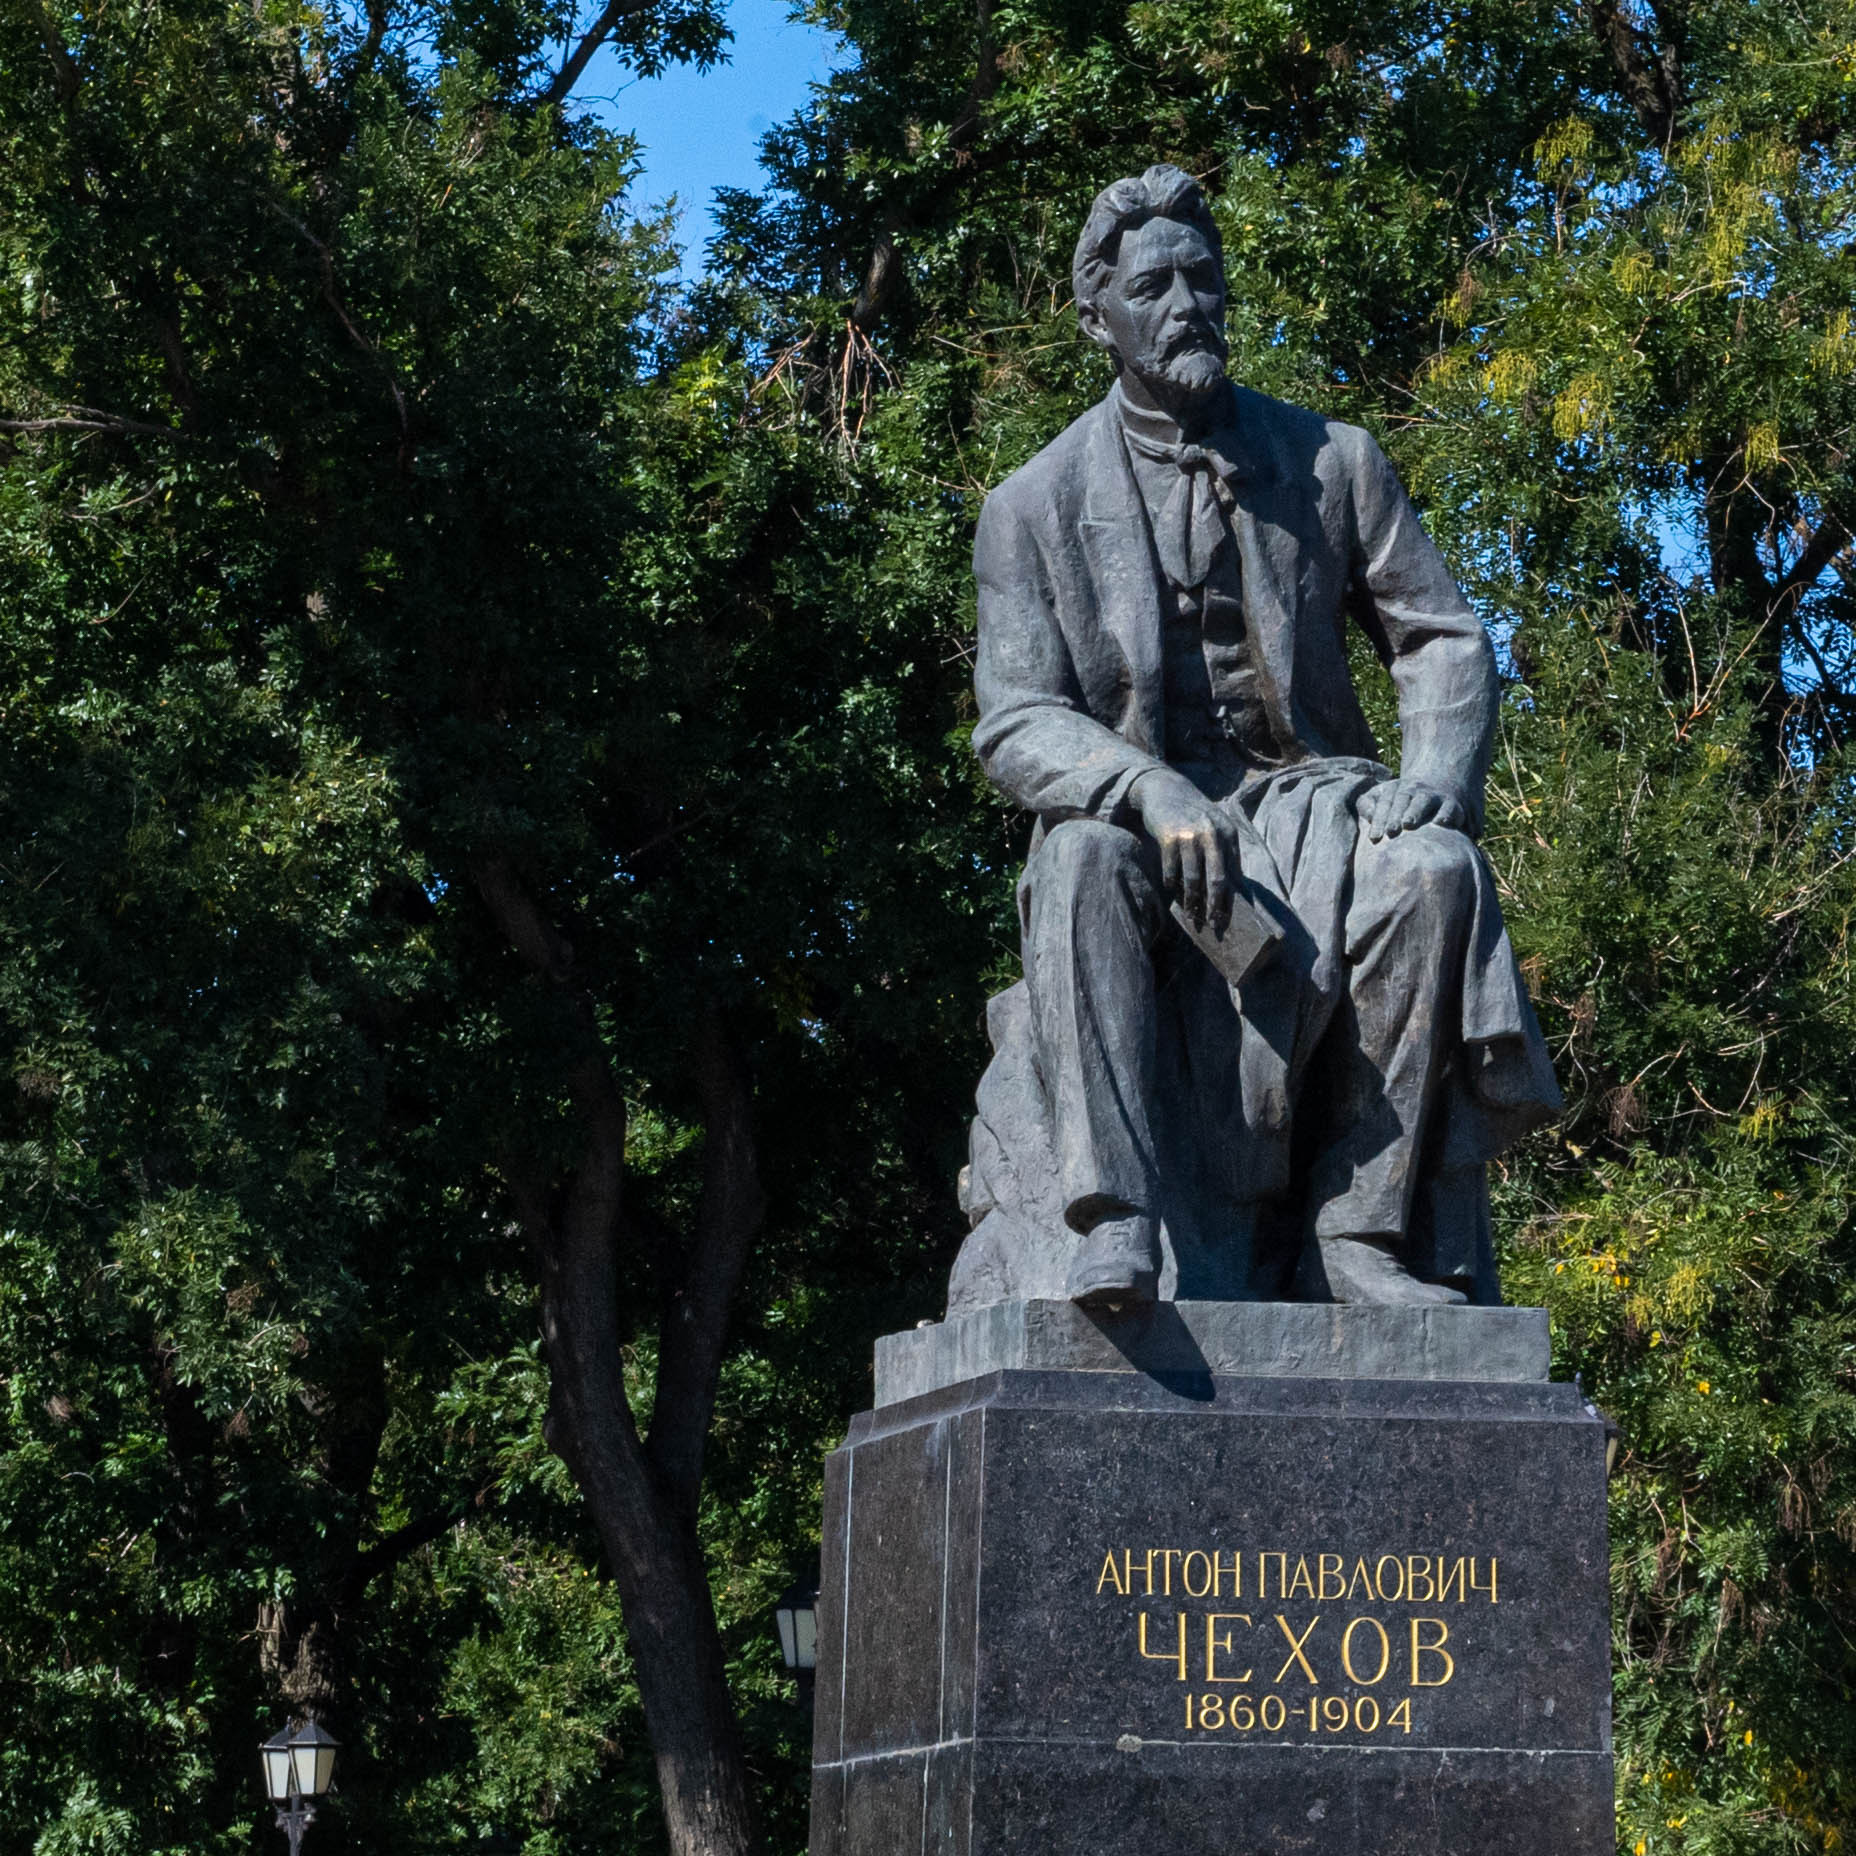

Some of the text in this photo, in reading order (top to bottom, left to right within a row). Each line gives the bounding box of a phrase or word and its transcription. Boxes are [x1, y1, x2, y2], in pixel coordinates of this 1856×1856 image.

[1096, 1548, 1499, 1604] АНТОН ПАВЛОВИЧ
[1137, 1611, 1456, 1687] ЧЕХОВ
[1184, 1693, 1413, 1735] 1860-1904
